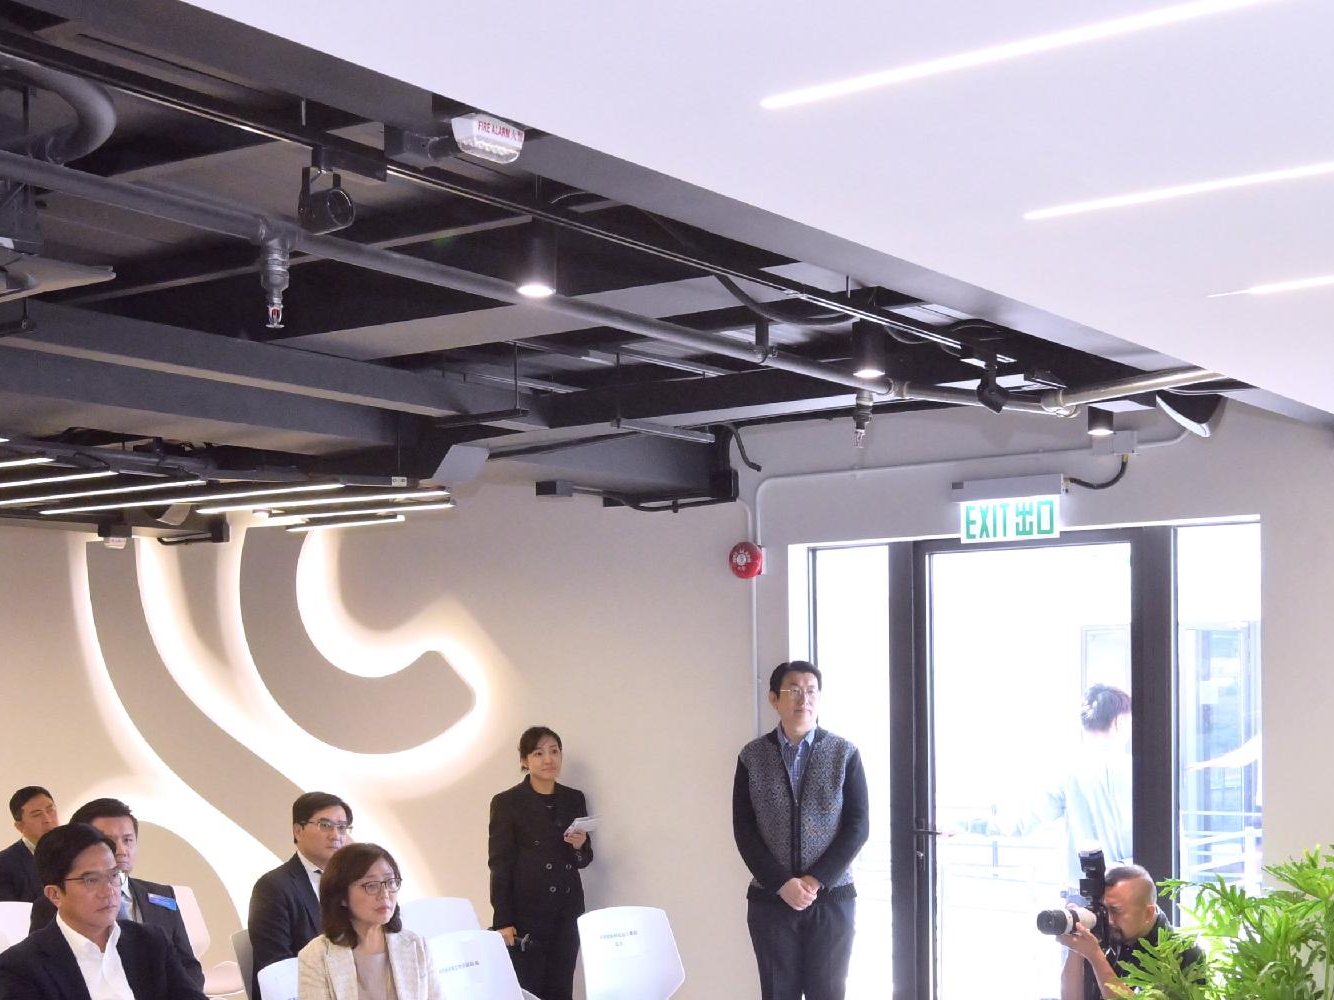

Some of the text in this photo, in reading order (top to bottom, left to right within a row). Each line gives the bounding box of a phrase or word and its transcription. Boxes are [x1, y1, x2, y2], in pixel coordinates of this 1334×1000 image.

[478, 121, 490, 133] FIRE
[492, 124, 510, 138] ALARM
[966, 500, 1055, 539] EXIT 出口
